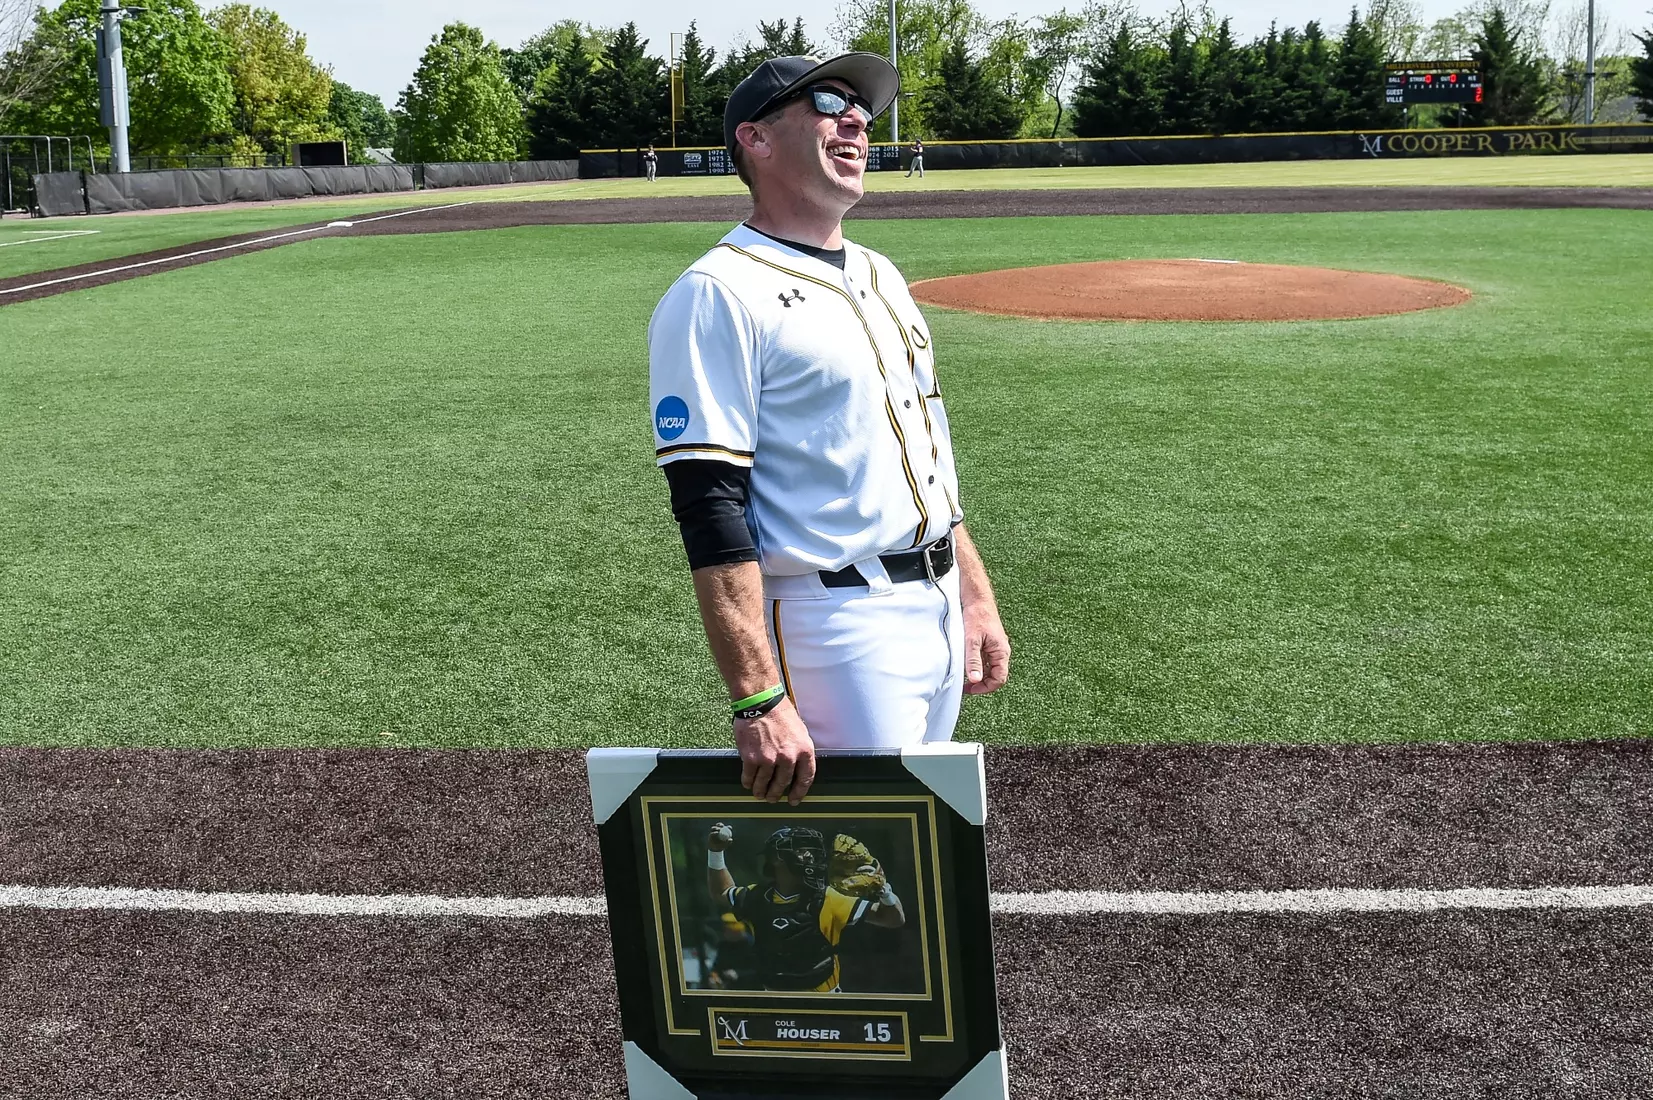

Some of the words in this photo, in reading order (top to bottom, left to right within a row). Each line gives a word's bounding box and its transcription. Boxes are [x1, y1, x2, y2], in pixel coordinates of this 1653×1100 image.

[1387, 132, 1500, 154] COOPER
[1503, 131, 1585, 152] PARK
[659, 416, 686, 429] NCAA
[743, 710, 762, 718] FCA
[776, 1028, 841, 1040] HOUSER
[863, 1022, 892, 1042] 15
